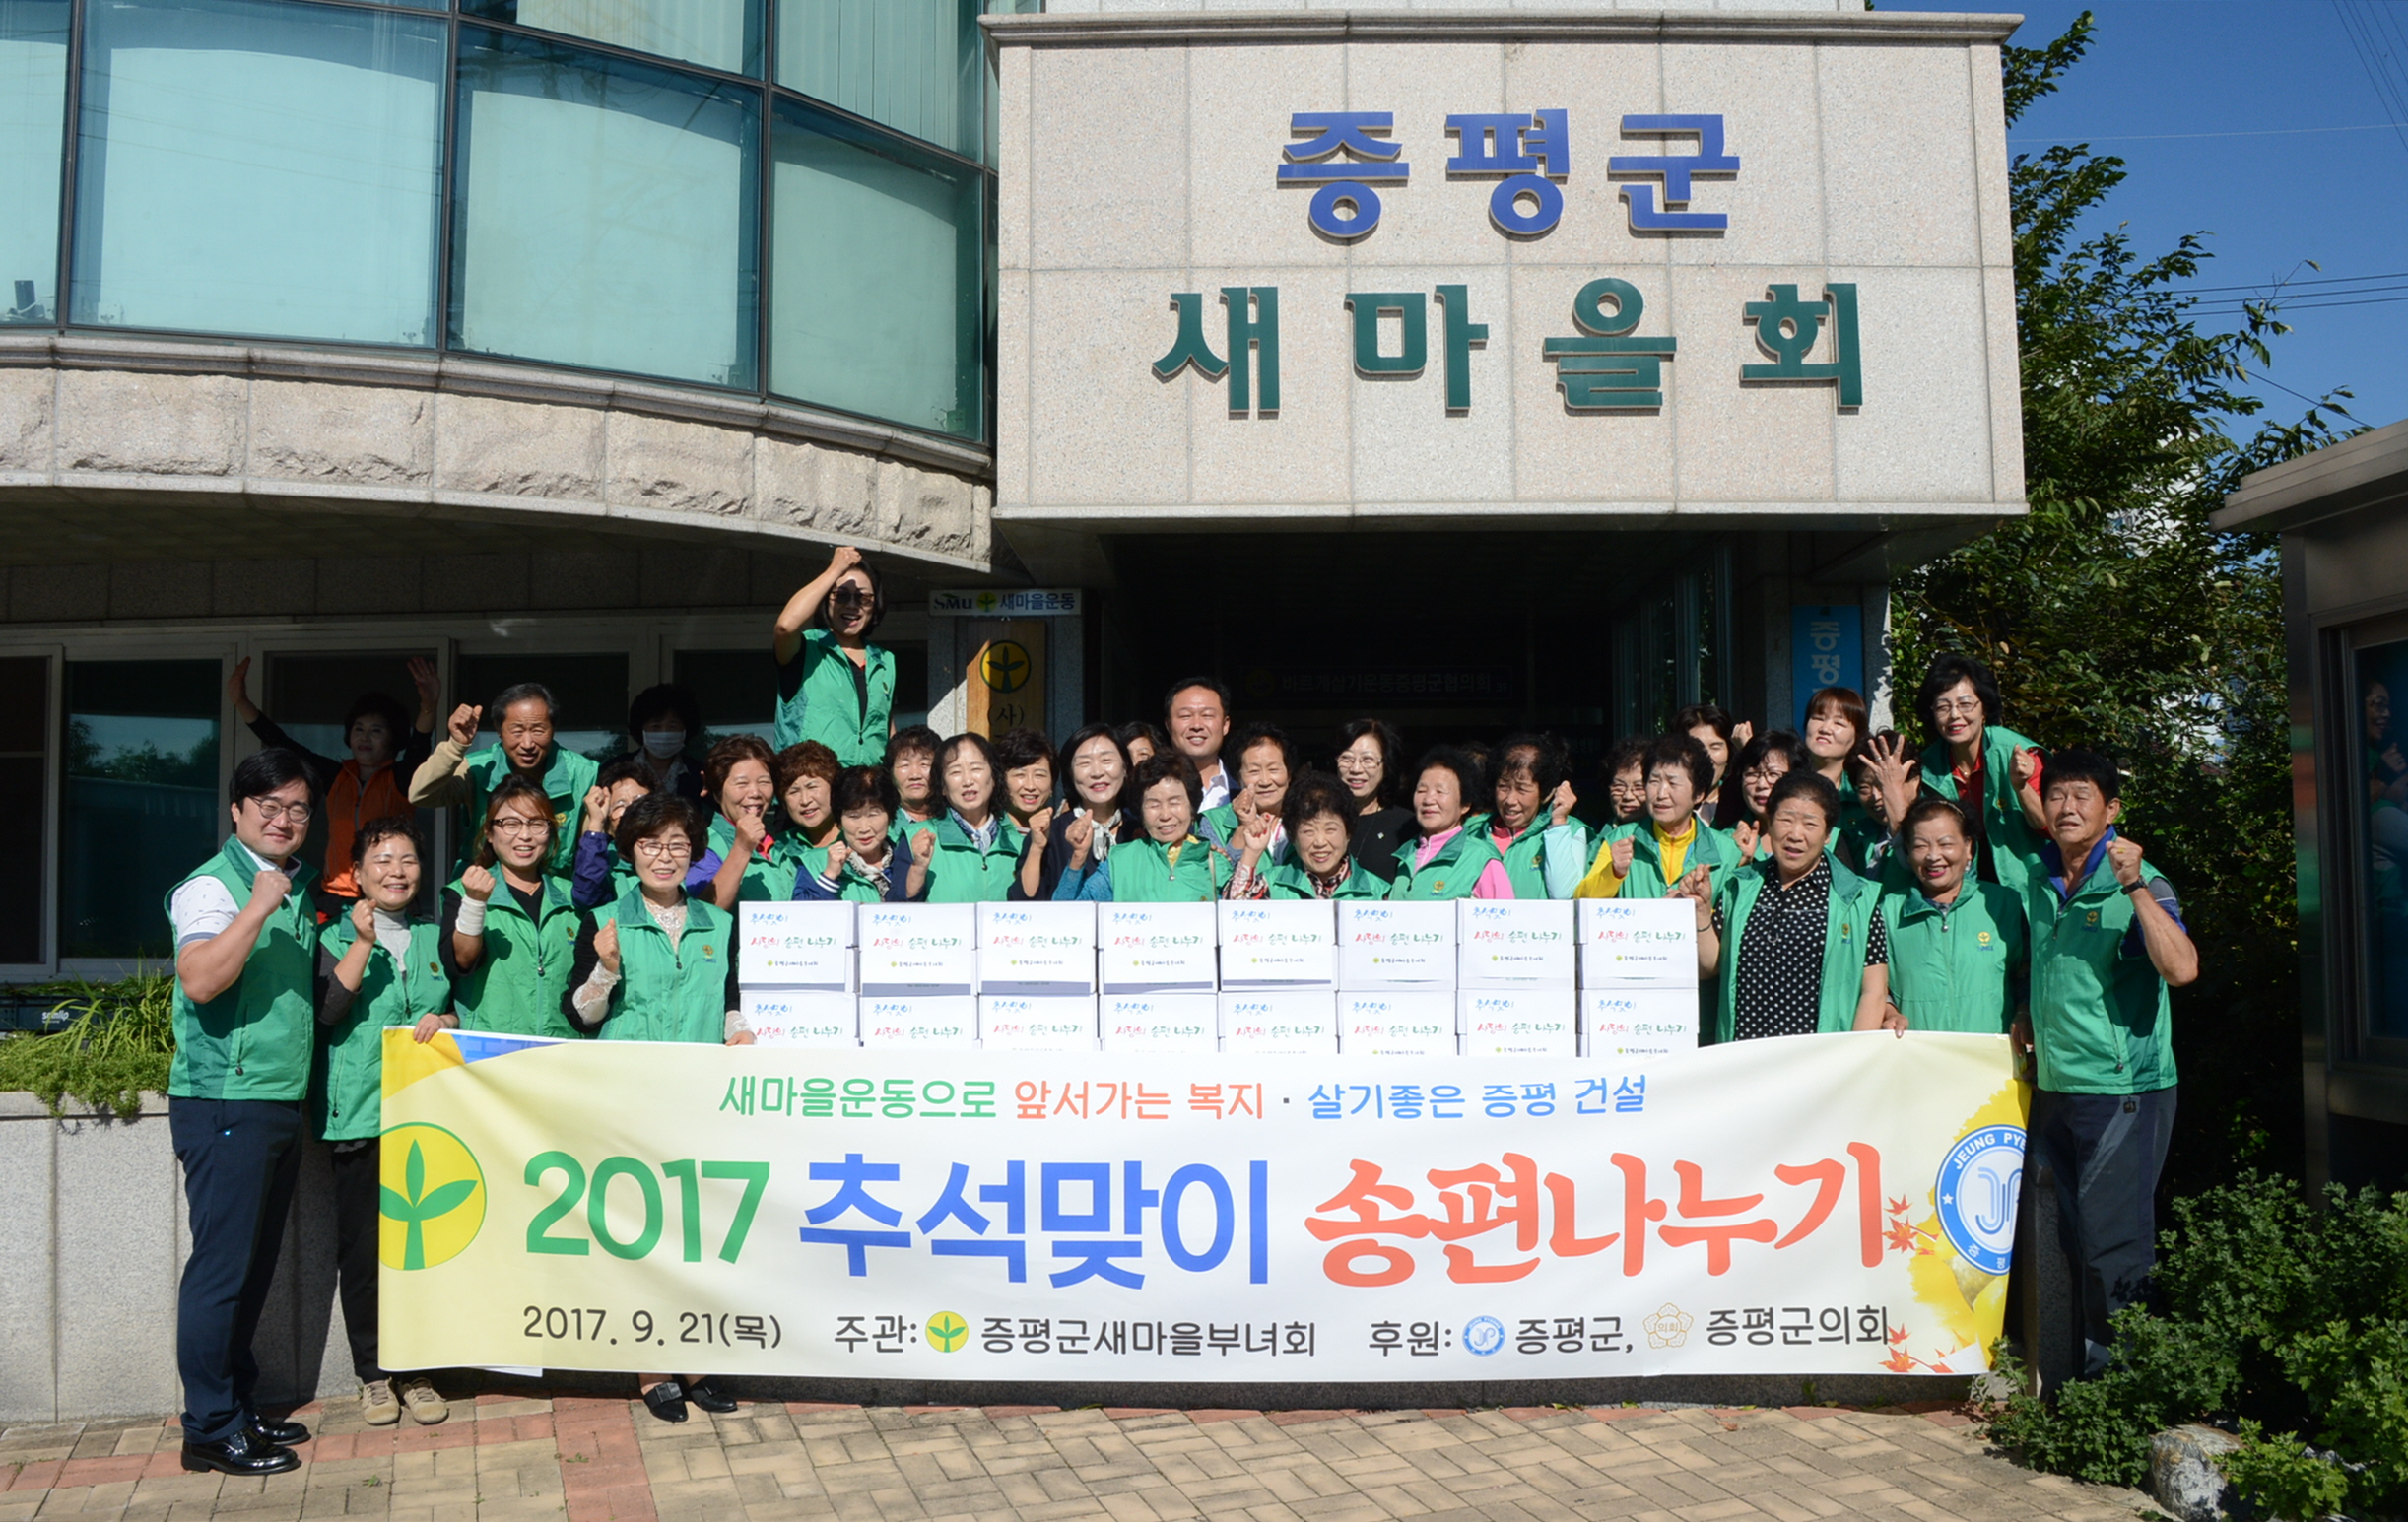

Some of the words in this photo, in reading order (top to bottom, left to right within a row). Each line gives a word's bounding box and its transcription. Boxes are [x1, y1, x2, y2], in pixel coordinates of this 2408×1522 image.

[1277, 108, 1741, 239] 증평군
[1152, 278, 1864, 416] 새마을회
[933, 593, 973, 610] SMU
[999, 593, 1076, 611] 새마을운동
[1810, 622, 1840, 692] 증평
[987, 703, 1024, 727] (사)
[719, 1075, 997, 1119] 새마을운동으로
[1015, 1080, 1171, 1120] 앞서가는
[1188, 1083, 1263, 1120] 복지
[1307, 1083, 1466, 1120] 살기좋은
[1481, 1082, 1557, 1119] 증평
[1575, 1074, 1647, 1115] 건설
[1953, 1133, 1996, 1170] JEUNG
[523, 1150, 770, 1264] 2017
[799, 1153, 1269, 1290] 추석맞이
[1304, 1141, 1883, 1288] 송편나누기
[523, 1305, 618, 1346] 2017.
[632, 1310, 665, 1347] 9.
[679, 1311, 782, 1350] 21(목)
[835, 1315, 917, 1353] 주관:
[981, 1318, 1315, 1357] 증평군새마을부녀회
[1369, 1320, 1452, 1357] 후원:
[1515, 1316, 1633, 1355] 증평군,
[1706, 1304, 1890, 1346] 증평군의회
